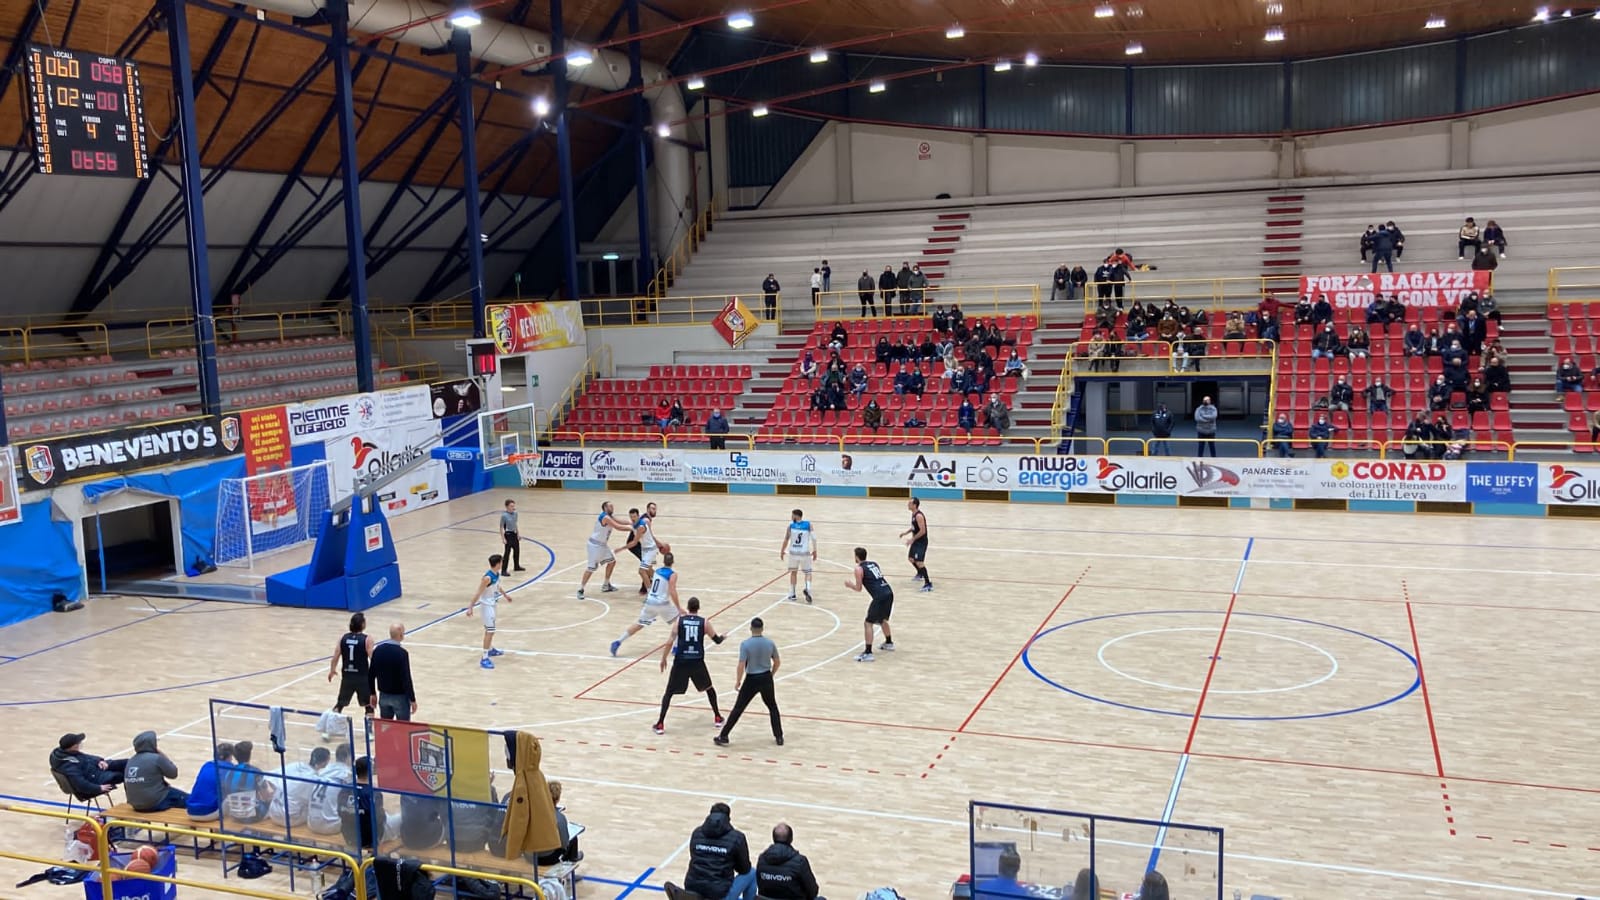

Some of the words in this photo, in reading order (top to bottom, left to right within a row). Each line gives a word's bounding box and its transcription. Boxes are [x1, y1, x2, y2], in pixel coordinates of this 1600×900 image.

[53, 51, 73, 59] LOCALI
[45, 56, 80, 79] 060
[90, 62, 123, 84] 058
[56, 86, 79, 107] 02
[96, 91, 118, 111] 00
[86, 123, 97, 139] 4
[71, 150, 117, 171] 0656
[1380, 272, 1475, 291] RAGAZZI
[1397, 290, 1439, 307] CON
[290, 404, 350, 424] PIEMME
[295, 418, 345, 435] UFFICIO
[61, 428, 199, 472] BENEVENTO
[546, 453, 582, 467] Agrifer
[1019, 457, 1077, 471] miwa
[691, 466, 723, 476] GNARRA
[725, 467, 779, 477] COSTRUZIONI
[795, 476, 822, 484] Duomo
[1353, 462, 1447, 481] CONAD
[1019, 472, 1088, 490] energia
[1339, 481, 1397, 489] colonnette
[1399, 482, 1458, 491] Benevento
[1469, 475, 1492, 486] THE
[1496, 475, 1535, 488] LIFFEY
[1349, 490, 1366, 498] dei
[1395, 490, 1428, 500] Leva
[652, 579, 660, 594] 0
[684, 625, 698, 642] 14
[348, 645, 355, 661] 1
